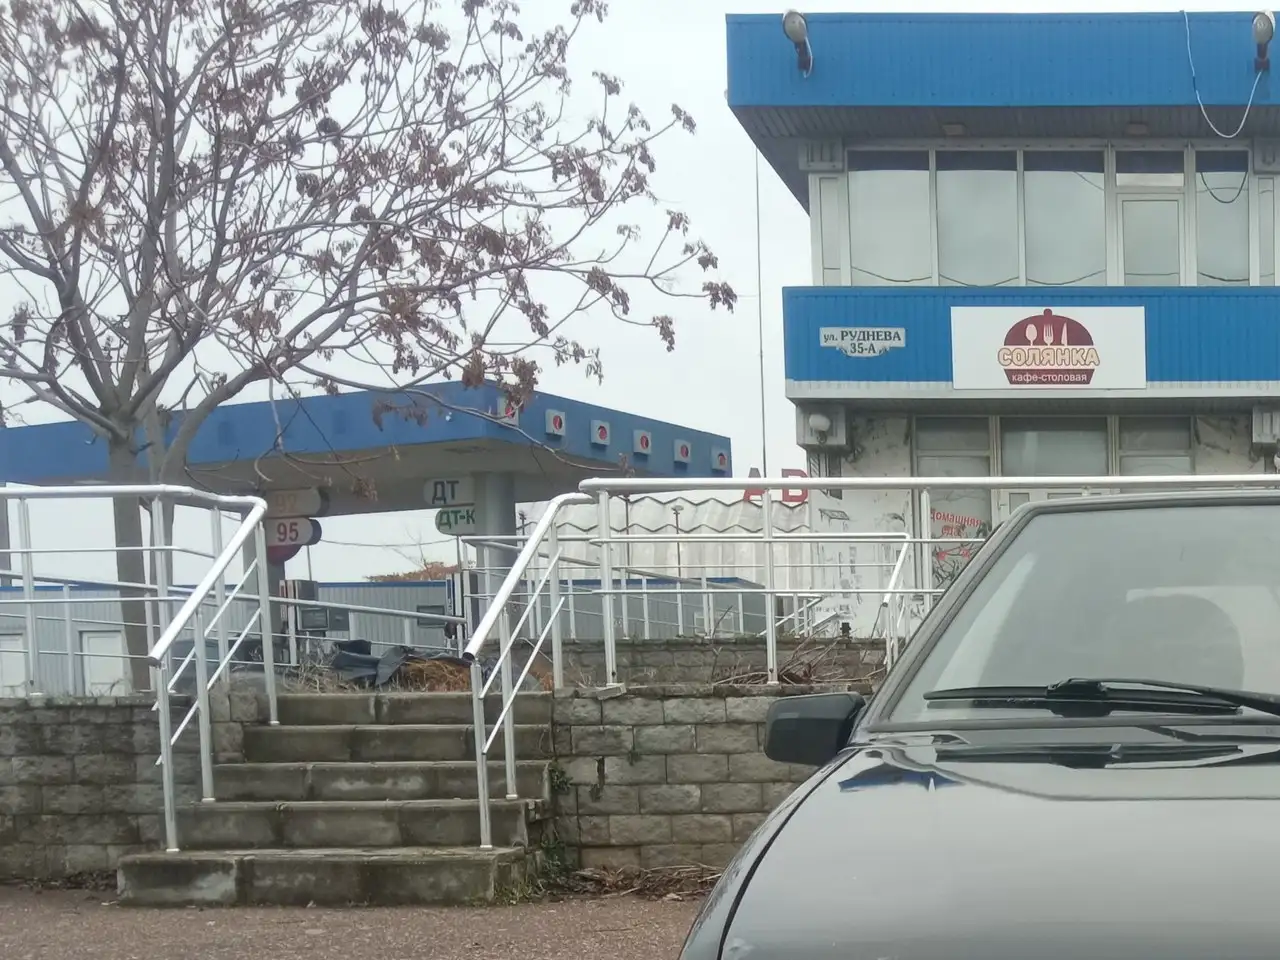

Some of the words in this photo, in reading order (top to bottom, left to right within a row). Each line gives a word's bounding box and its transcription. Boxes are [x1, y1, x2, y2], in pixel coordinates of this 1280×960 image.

[823, 333, 838, 343] ул.
[840, 330, 901, 341] РУДНЕВА
[850, 343, 876, 354] 35-А
[998, 347, 1100, 366] СОЛЯНКА
[1012, 373, 1087, 383] кафе-столовая
[432, 480, 459, 504] ДТ
[277, 522, 298, 542] 95
